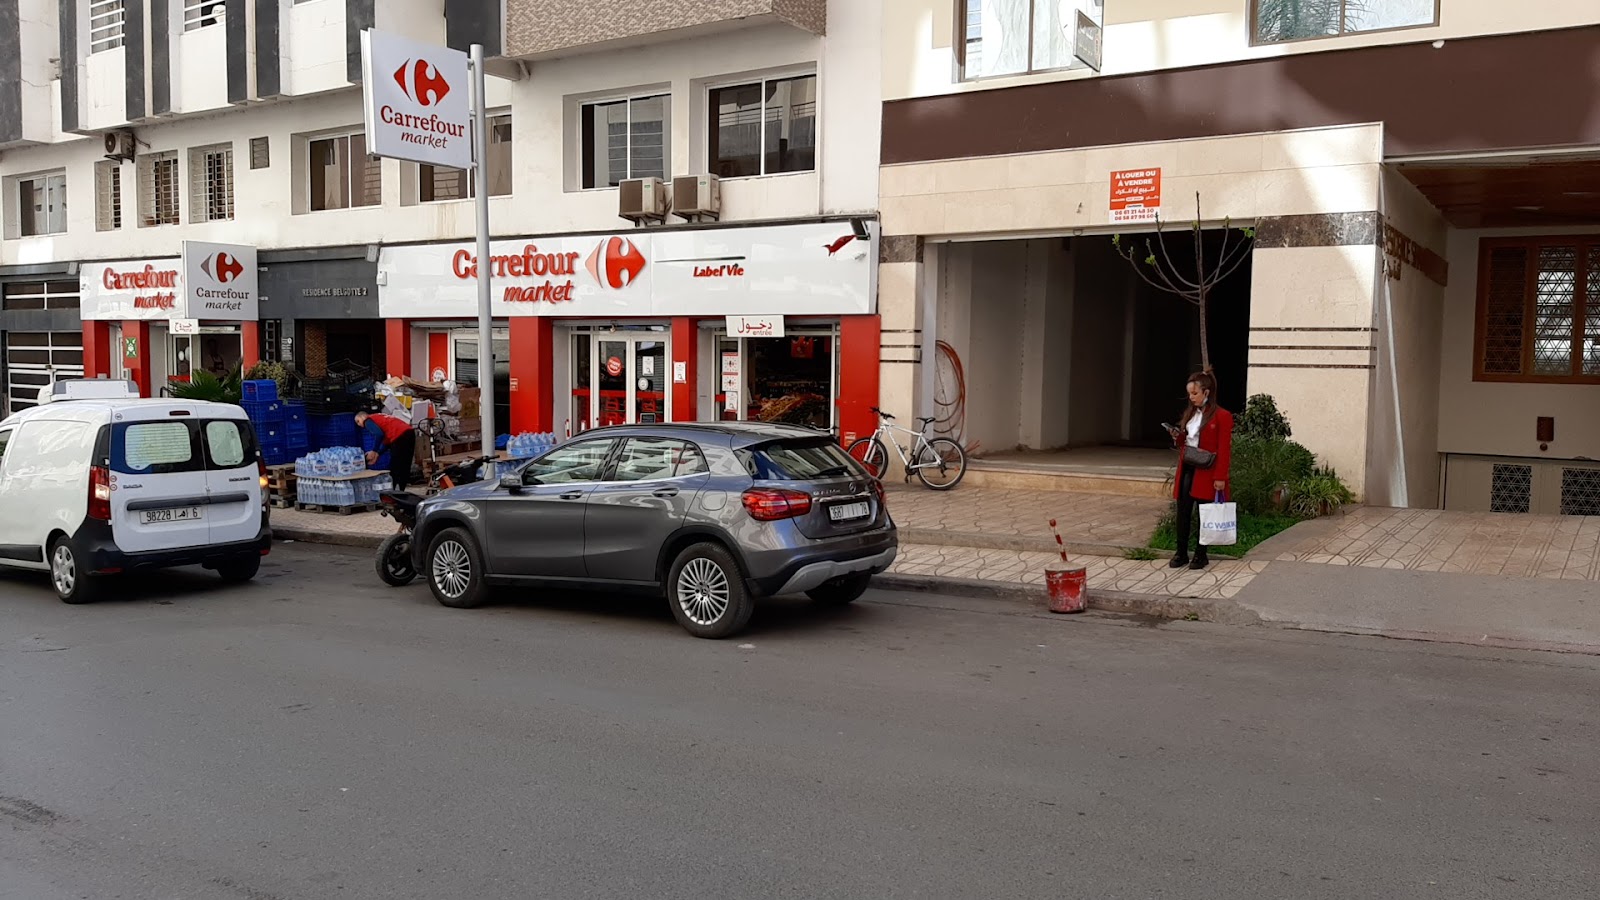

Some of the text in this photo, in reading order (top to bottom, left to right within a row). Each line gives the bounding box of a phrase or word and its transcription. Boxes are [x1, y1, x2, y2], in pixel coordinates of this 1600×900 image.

[380, 105, 465, 137] Carrefour
[401, 132, 448, 148] market
[103, 264, 178, 290] Carrefour
[196, 287, 250, 300] Carrefour
[503, 280, 574, 304] market
[134, 291, 177, 311] market
[205, 301, 242, 311] market
[737, 317, 773, 334] دخول
[146, 509, 171, 522] 98228
[1202, 521, 1214, 529] LC
